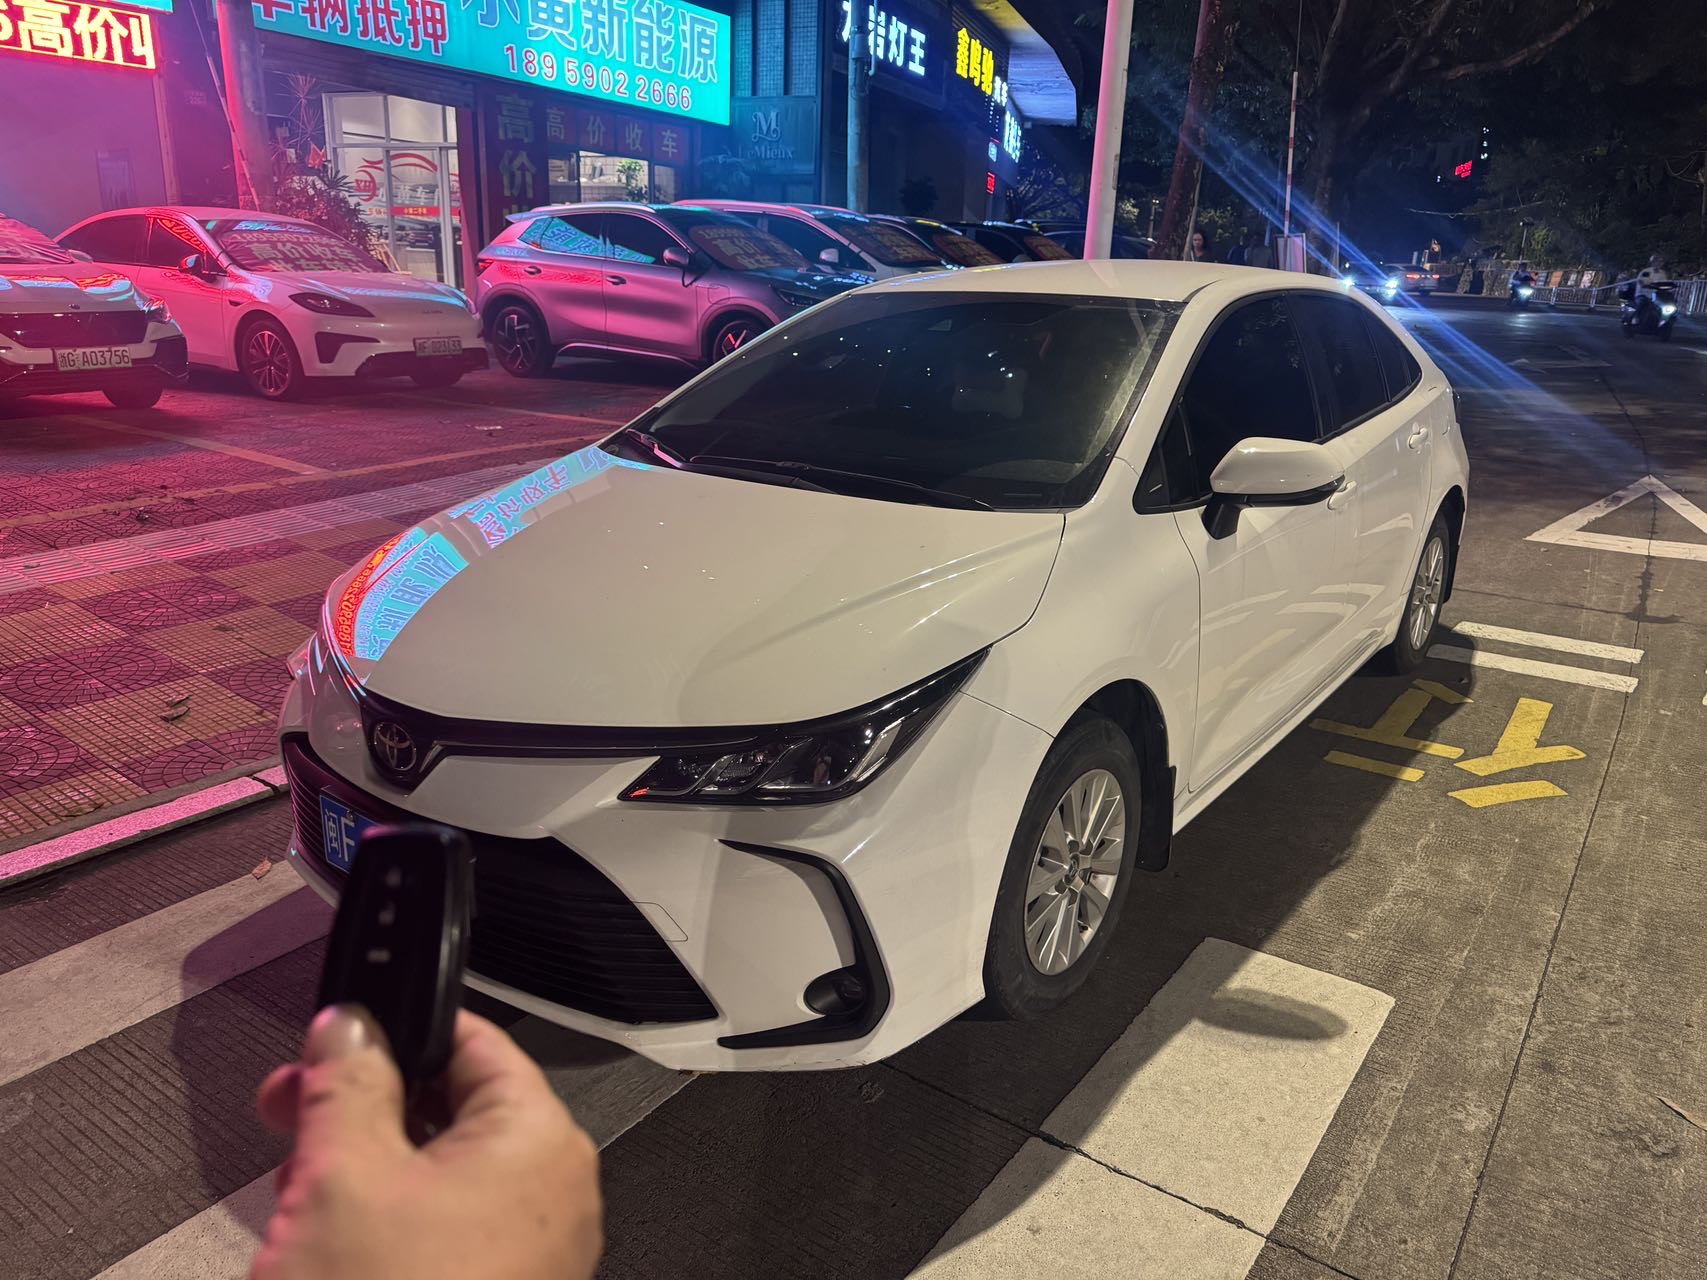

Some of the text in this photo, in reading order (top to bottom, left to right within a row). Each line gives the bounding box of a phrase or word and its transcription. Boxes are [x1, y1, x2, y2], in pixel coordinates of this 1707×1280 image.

[546, 106, 678, 157] 高价收车
[325, 808, 355, 862] 闽F
